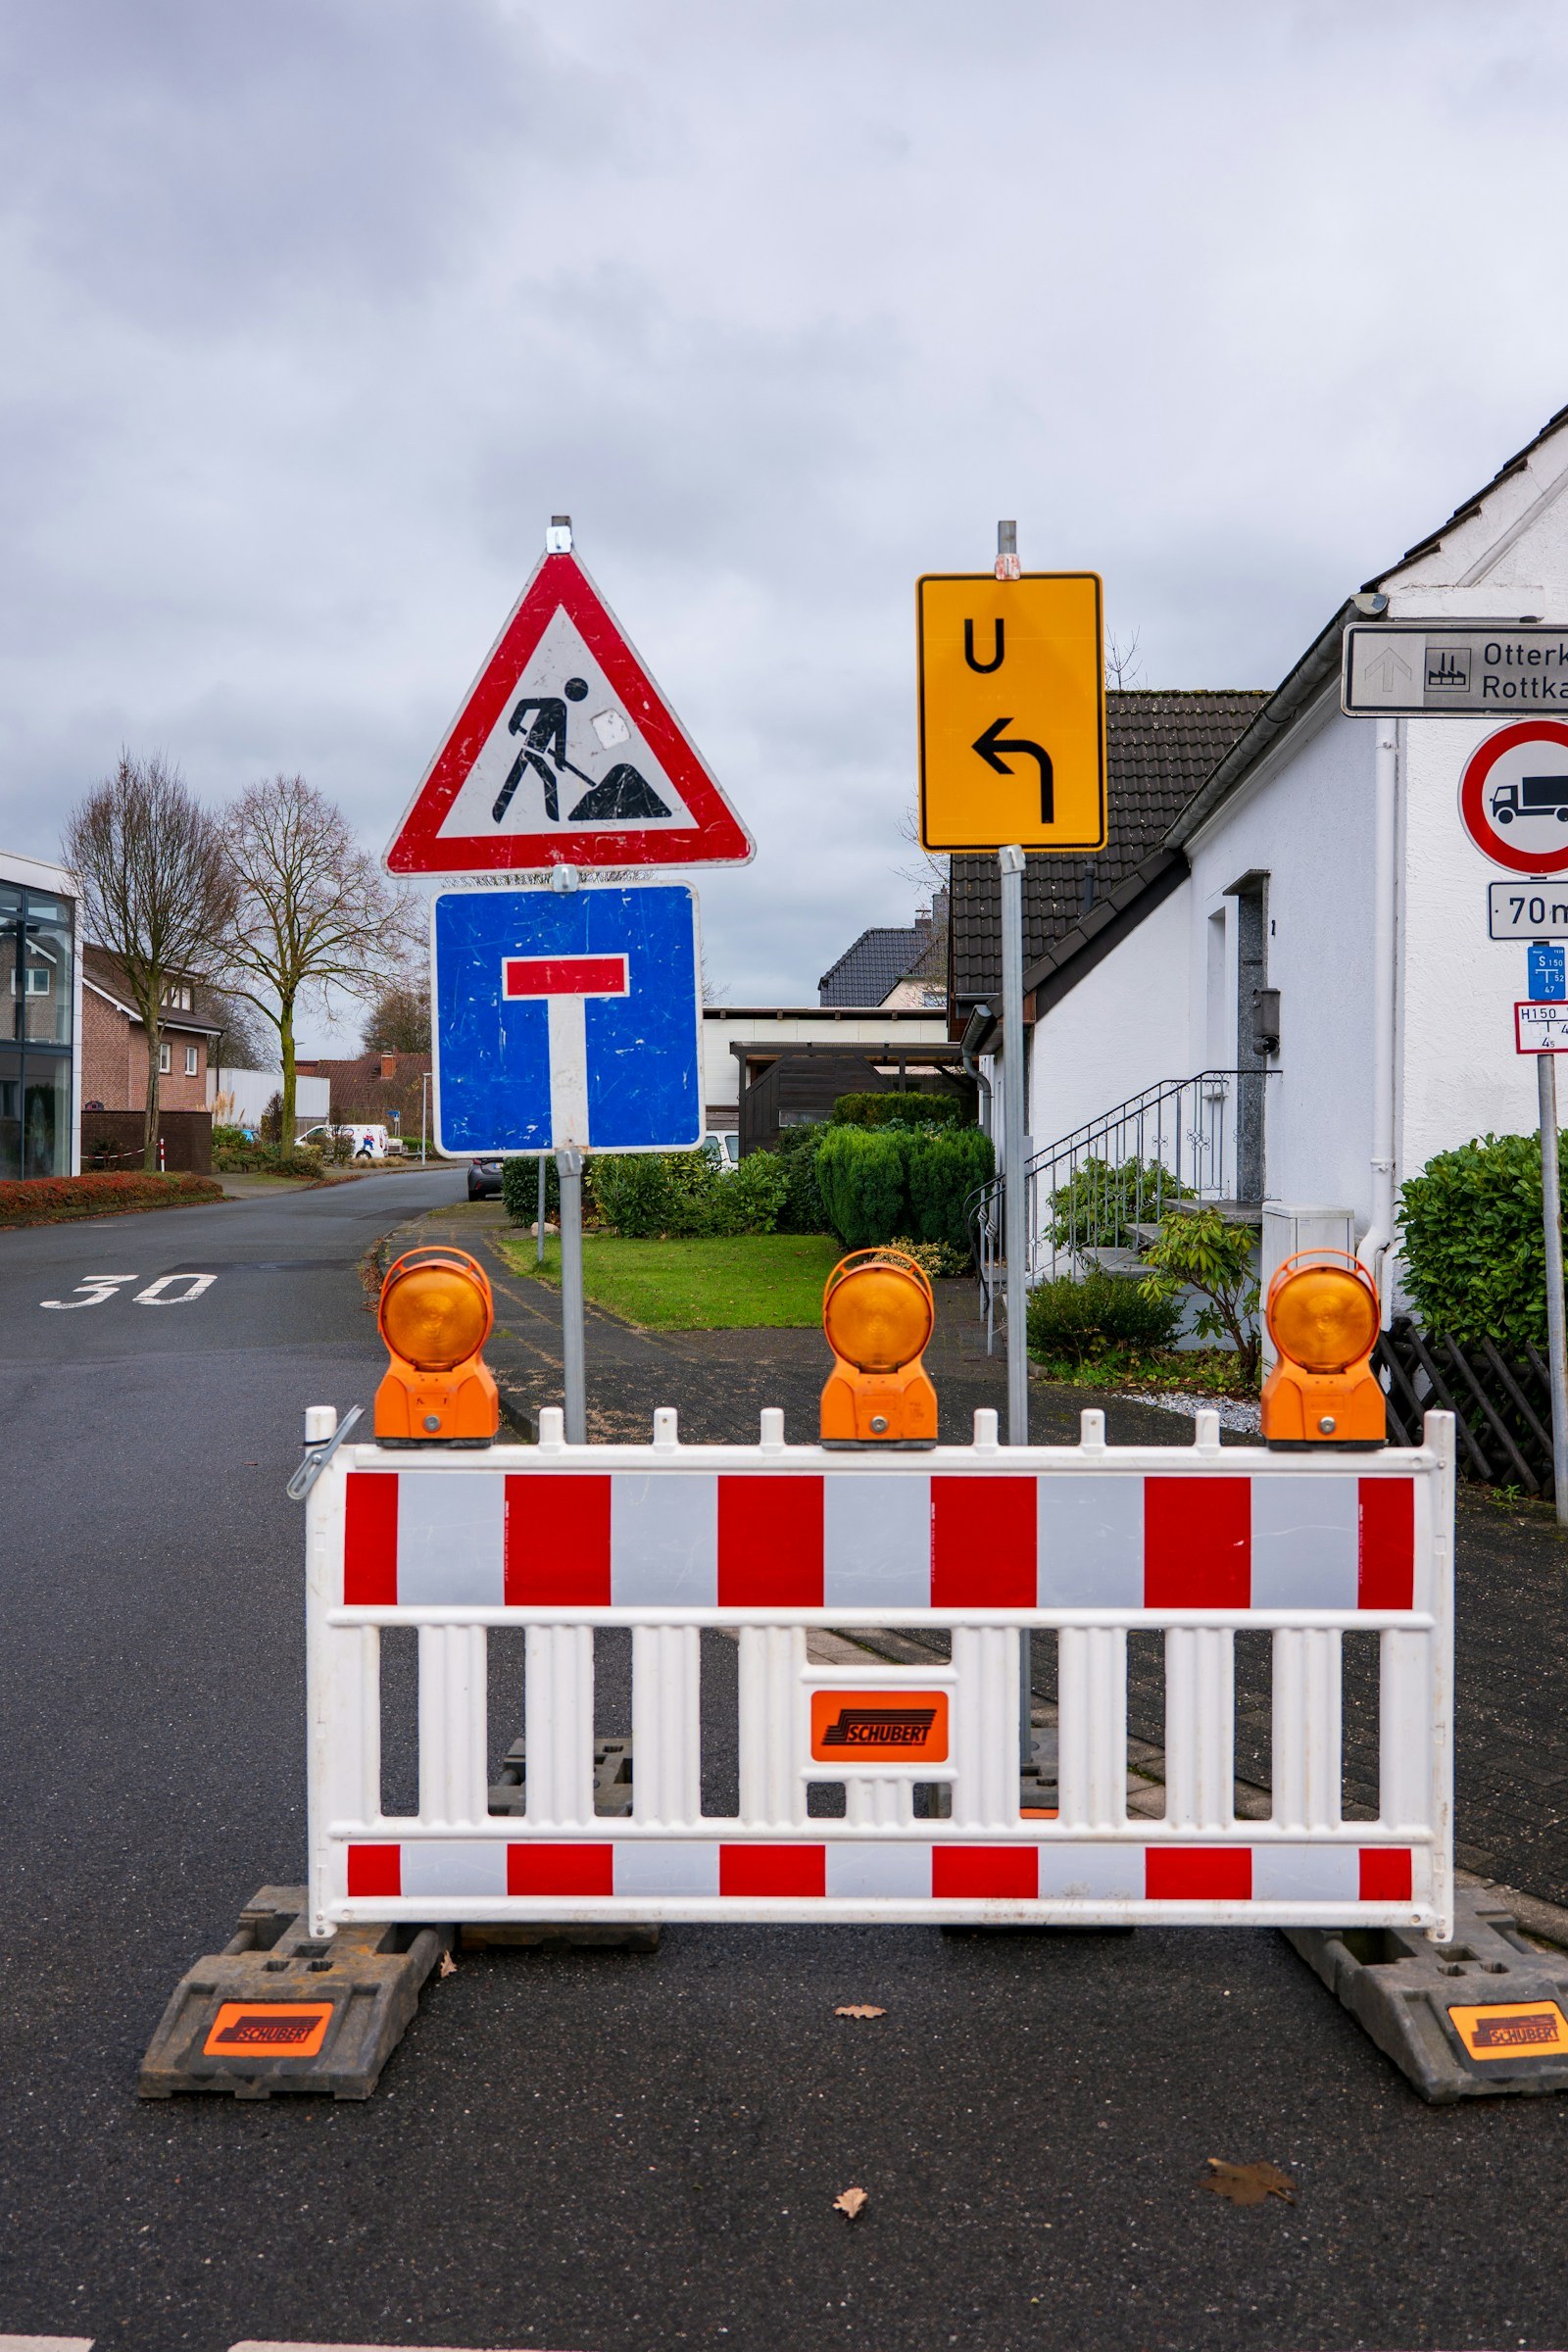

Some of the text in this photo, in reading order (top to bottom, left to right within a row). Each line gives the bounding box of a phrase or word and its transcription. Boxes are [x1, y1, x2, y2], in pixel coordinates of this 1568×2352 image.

[964, 618, 1004, 674] U
[1539, 956, 1546, 967] S
[39, 1273, 219, 1309] 30
[848, 1725, 931, 1741] SCHUBERT
[239, 2027, 313, 2040] SCHUBERT
[1491, 2026, 1558, 2042] SCHUBERT
